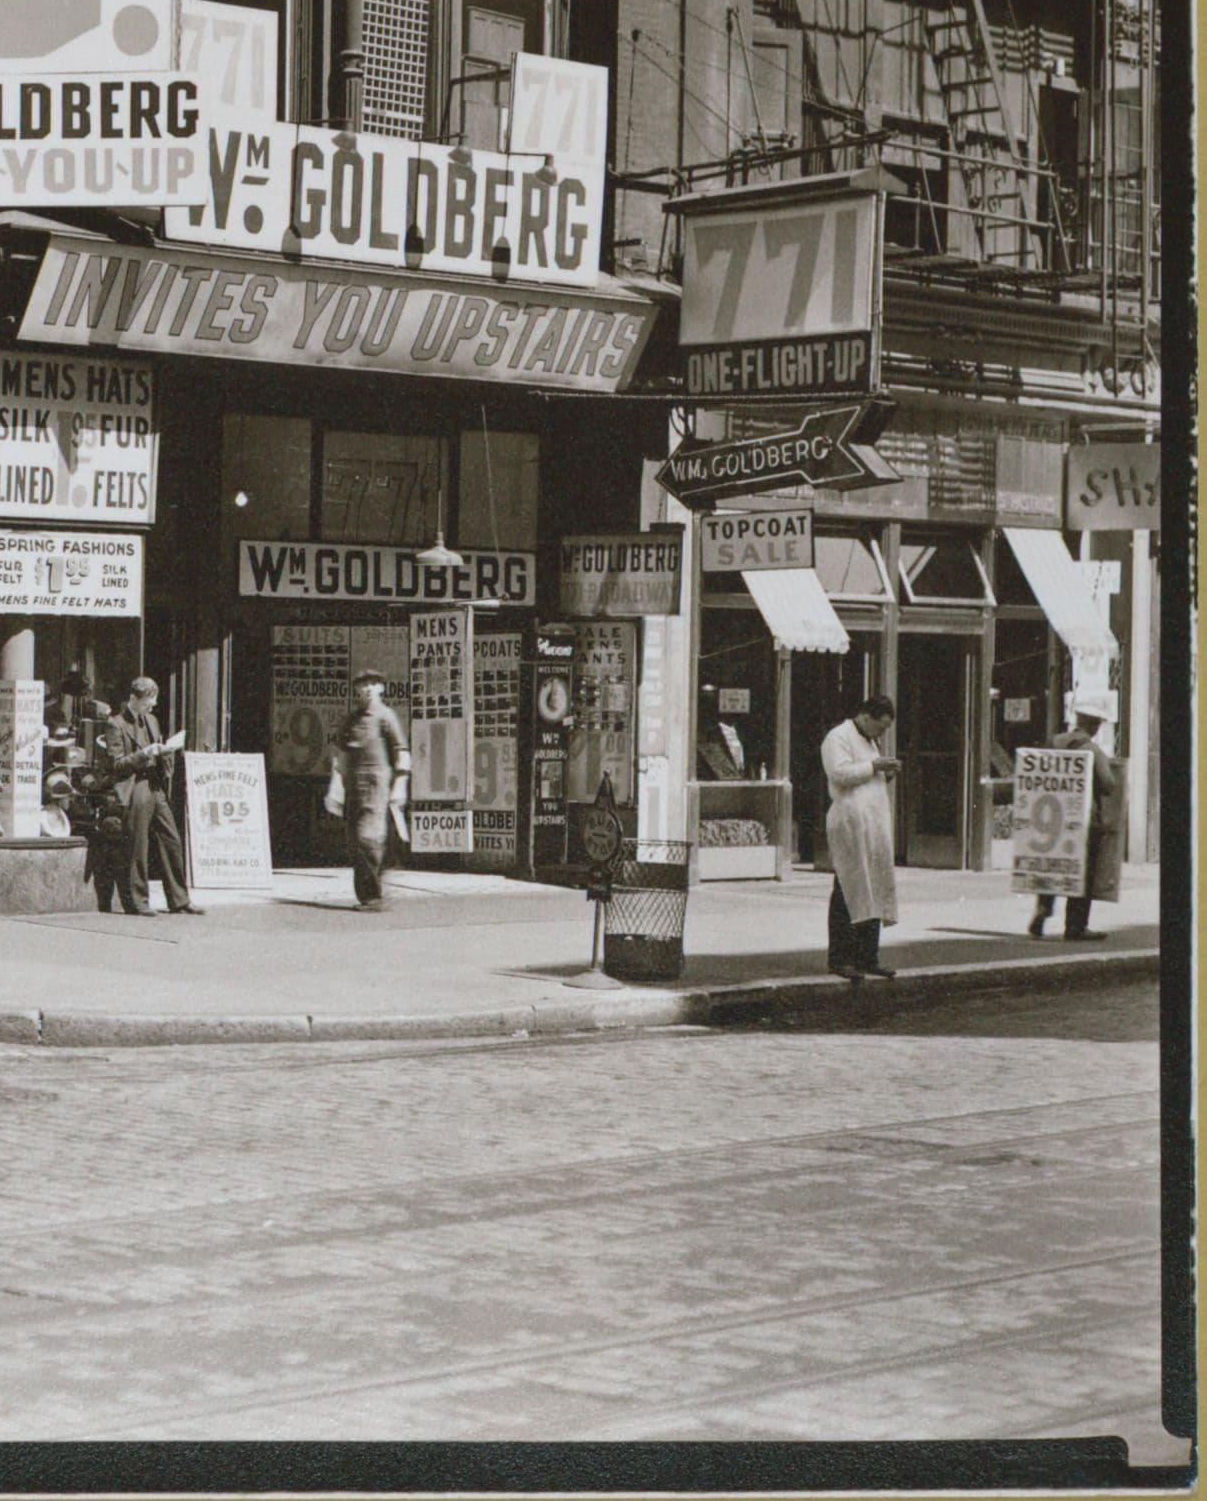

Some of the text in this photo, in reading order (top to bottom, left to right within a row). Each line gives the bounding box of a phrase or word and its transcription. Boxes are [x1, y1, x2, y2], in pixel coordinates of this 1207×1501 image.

[294, 141, 589, 270] GOLDBERG
[694, 208, 857, 343] 771
[44, 250, 644, 377] INVITES YOU UPSTAIRS
[1, 358, 150, 406] MENS HATS
[100, 415, 149, 449] FUR
[711, 436, 833, 480] GOLDBERG
[92, 470, 148, 510] FELTS
[707, 516, 807, 541] TOPCOAT
[62, 541, 136, 557] FASHIONS
[582, 543, 679, 573] GOLDBERG
[718, 542, 800, 566] SALE
[102, 564, 128, 575] SILK
[314, 548, 527, 601] GOLDBERG
[102, 577, 129, 588] LINED
[33, 596, 57, 607] FINE
[61, 597, 91, 608] FELT
[94, 598, 128, 609] HATS
[417, 617, 458, 638] MENS
[417, 642, 462, 657] PANTS
[474, 640, 522, 658] PCOATS
[579, 652, 627, 665] ANTS
[290, 681, 347, 698] GOLDBERG
[1023, 754, 1085, 774] SUITS
[1018, 775, 1085, 793] TOPCOATS
[414, 816, 467, 831] TOPCOAT
[420, 831, 462, 848] SALE
